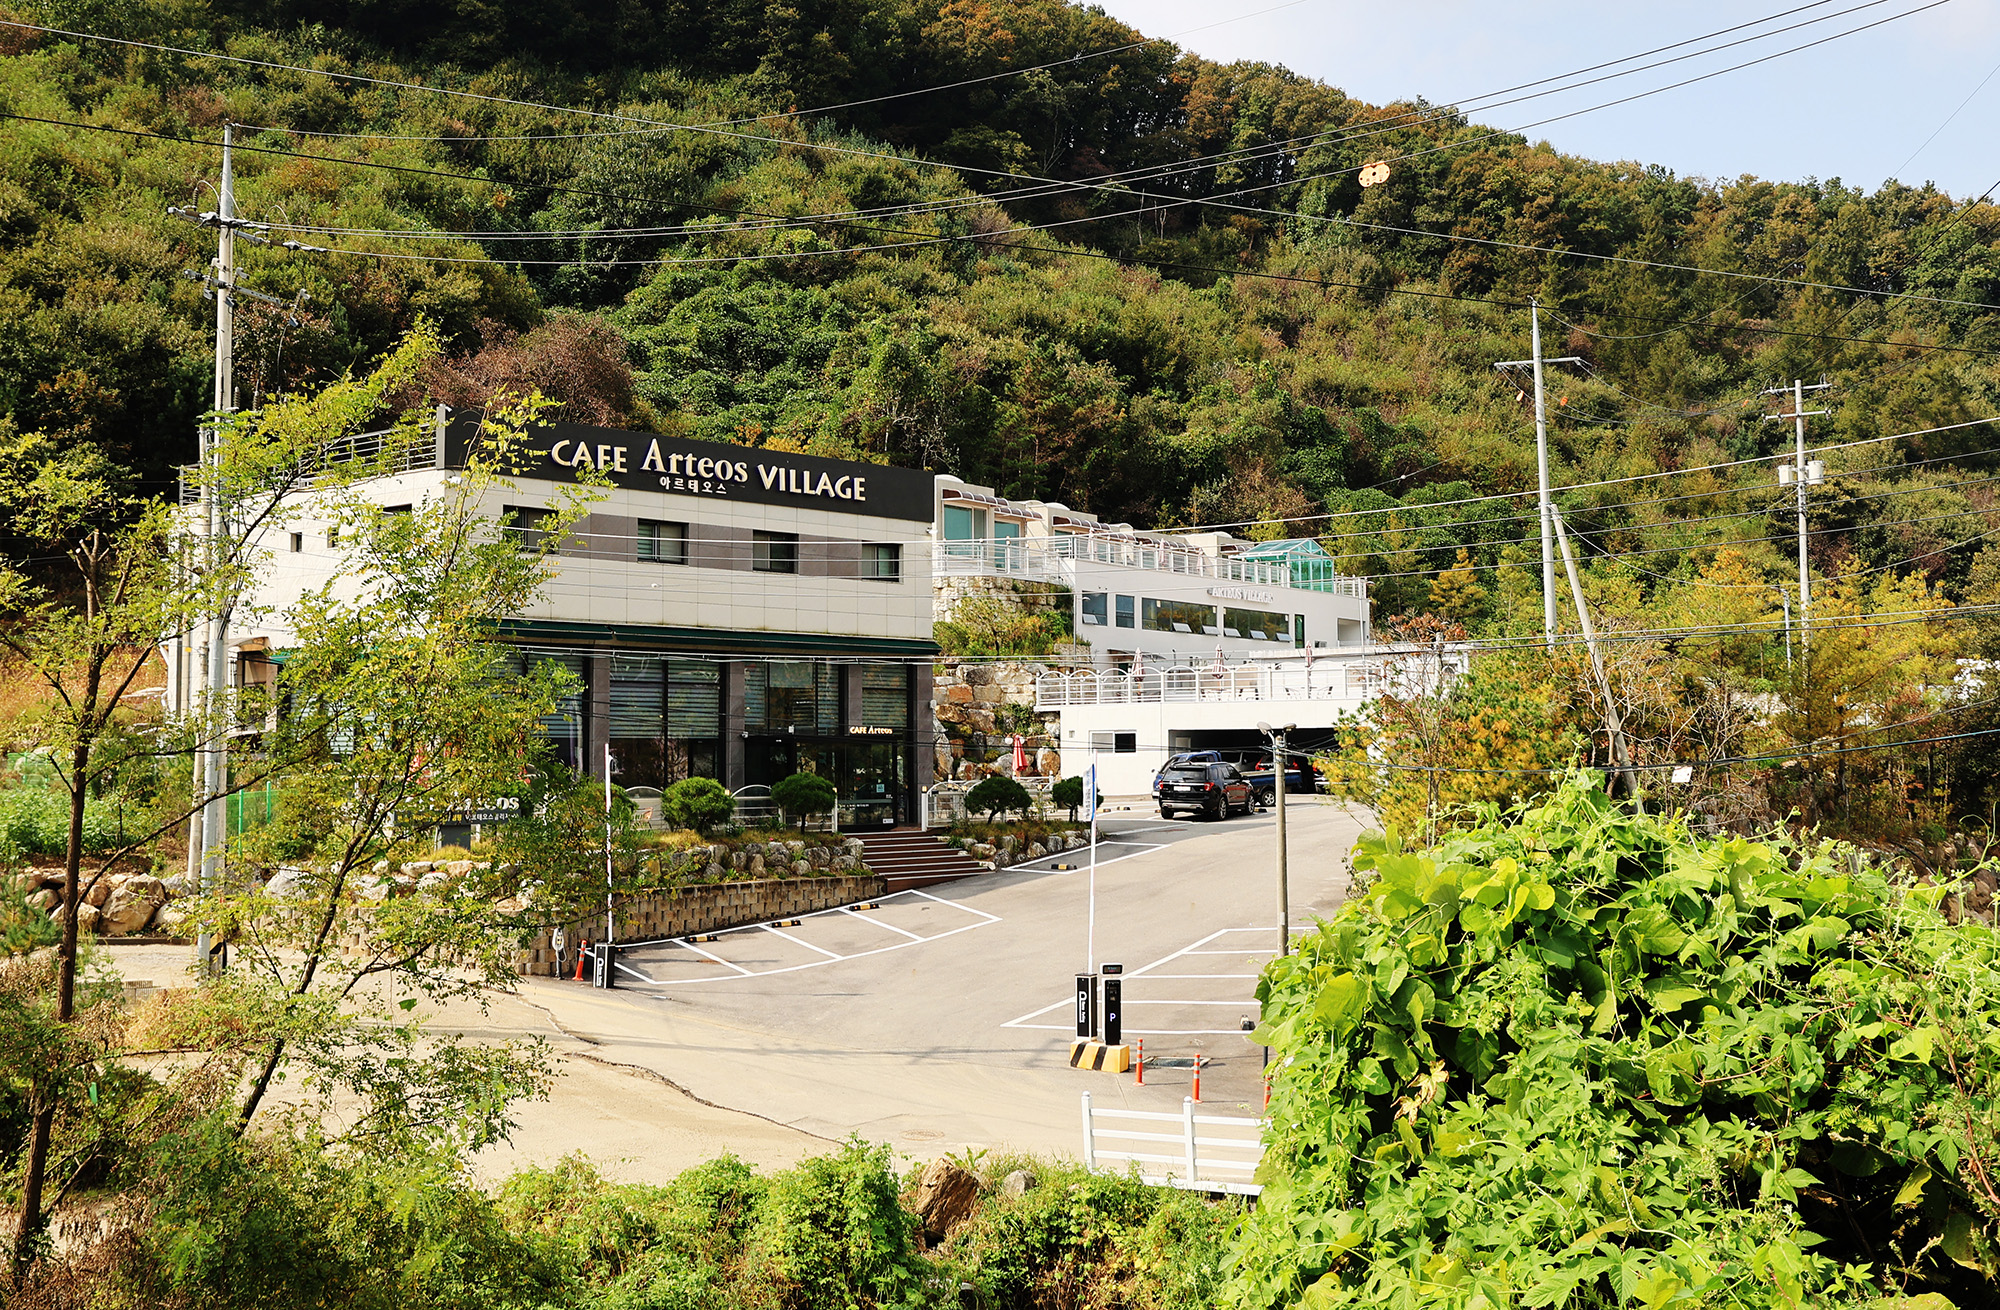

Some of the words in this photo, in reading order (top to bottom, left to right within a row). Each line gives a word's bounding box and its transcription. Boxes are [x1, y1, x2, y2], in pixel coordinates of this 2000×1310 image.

[551, 439, 628, 474] CAFE
[640, 438, 748, 483] Arteos
[757, 464, 866, 501] VILLAGE
[659, 476, 727, 495] 아르테오스
[850, 726, 867, 735] CAFE
[868, 724, 893, 735] Arteos
[1109, 1012, 1117, 1022] P
